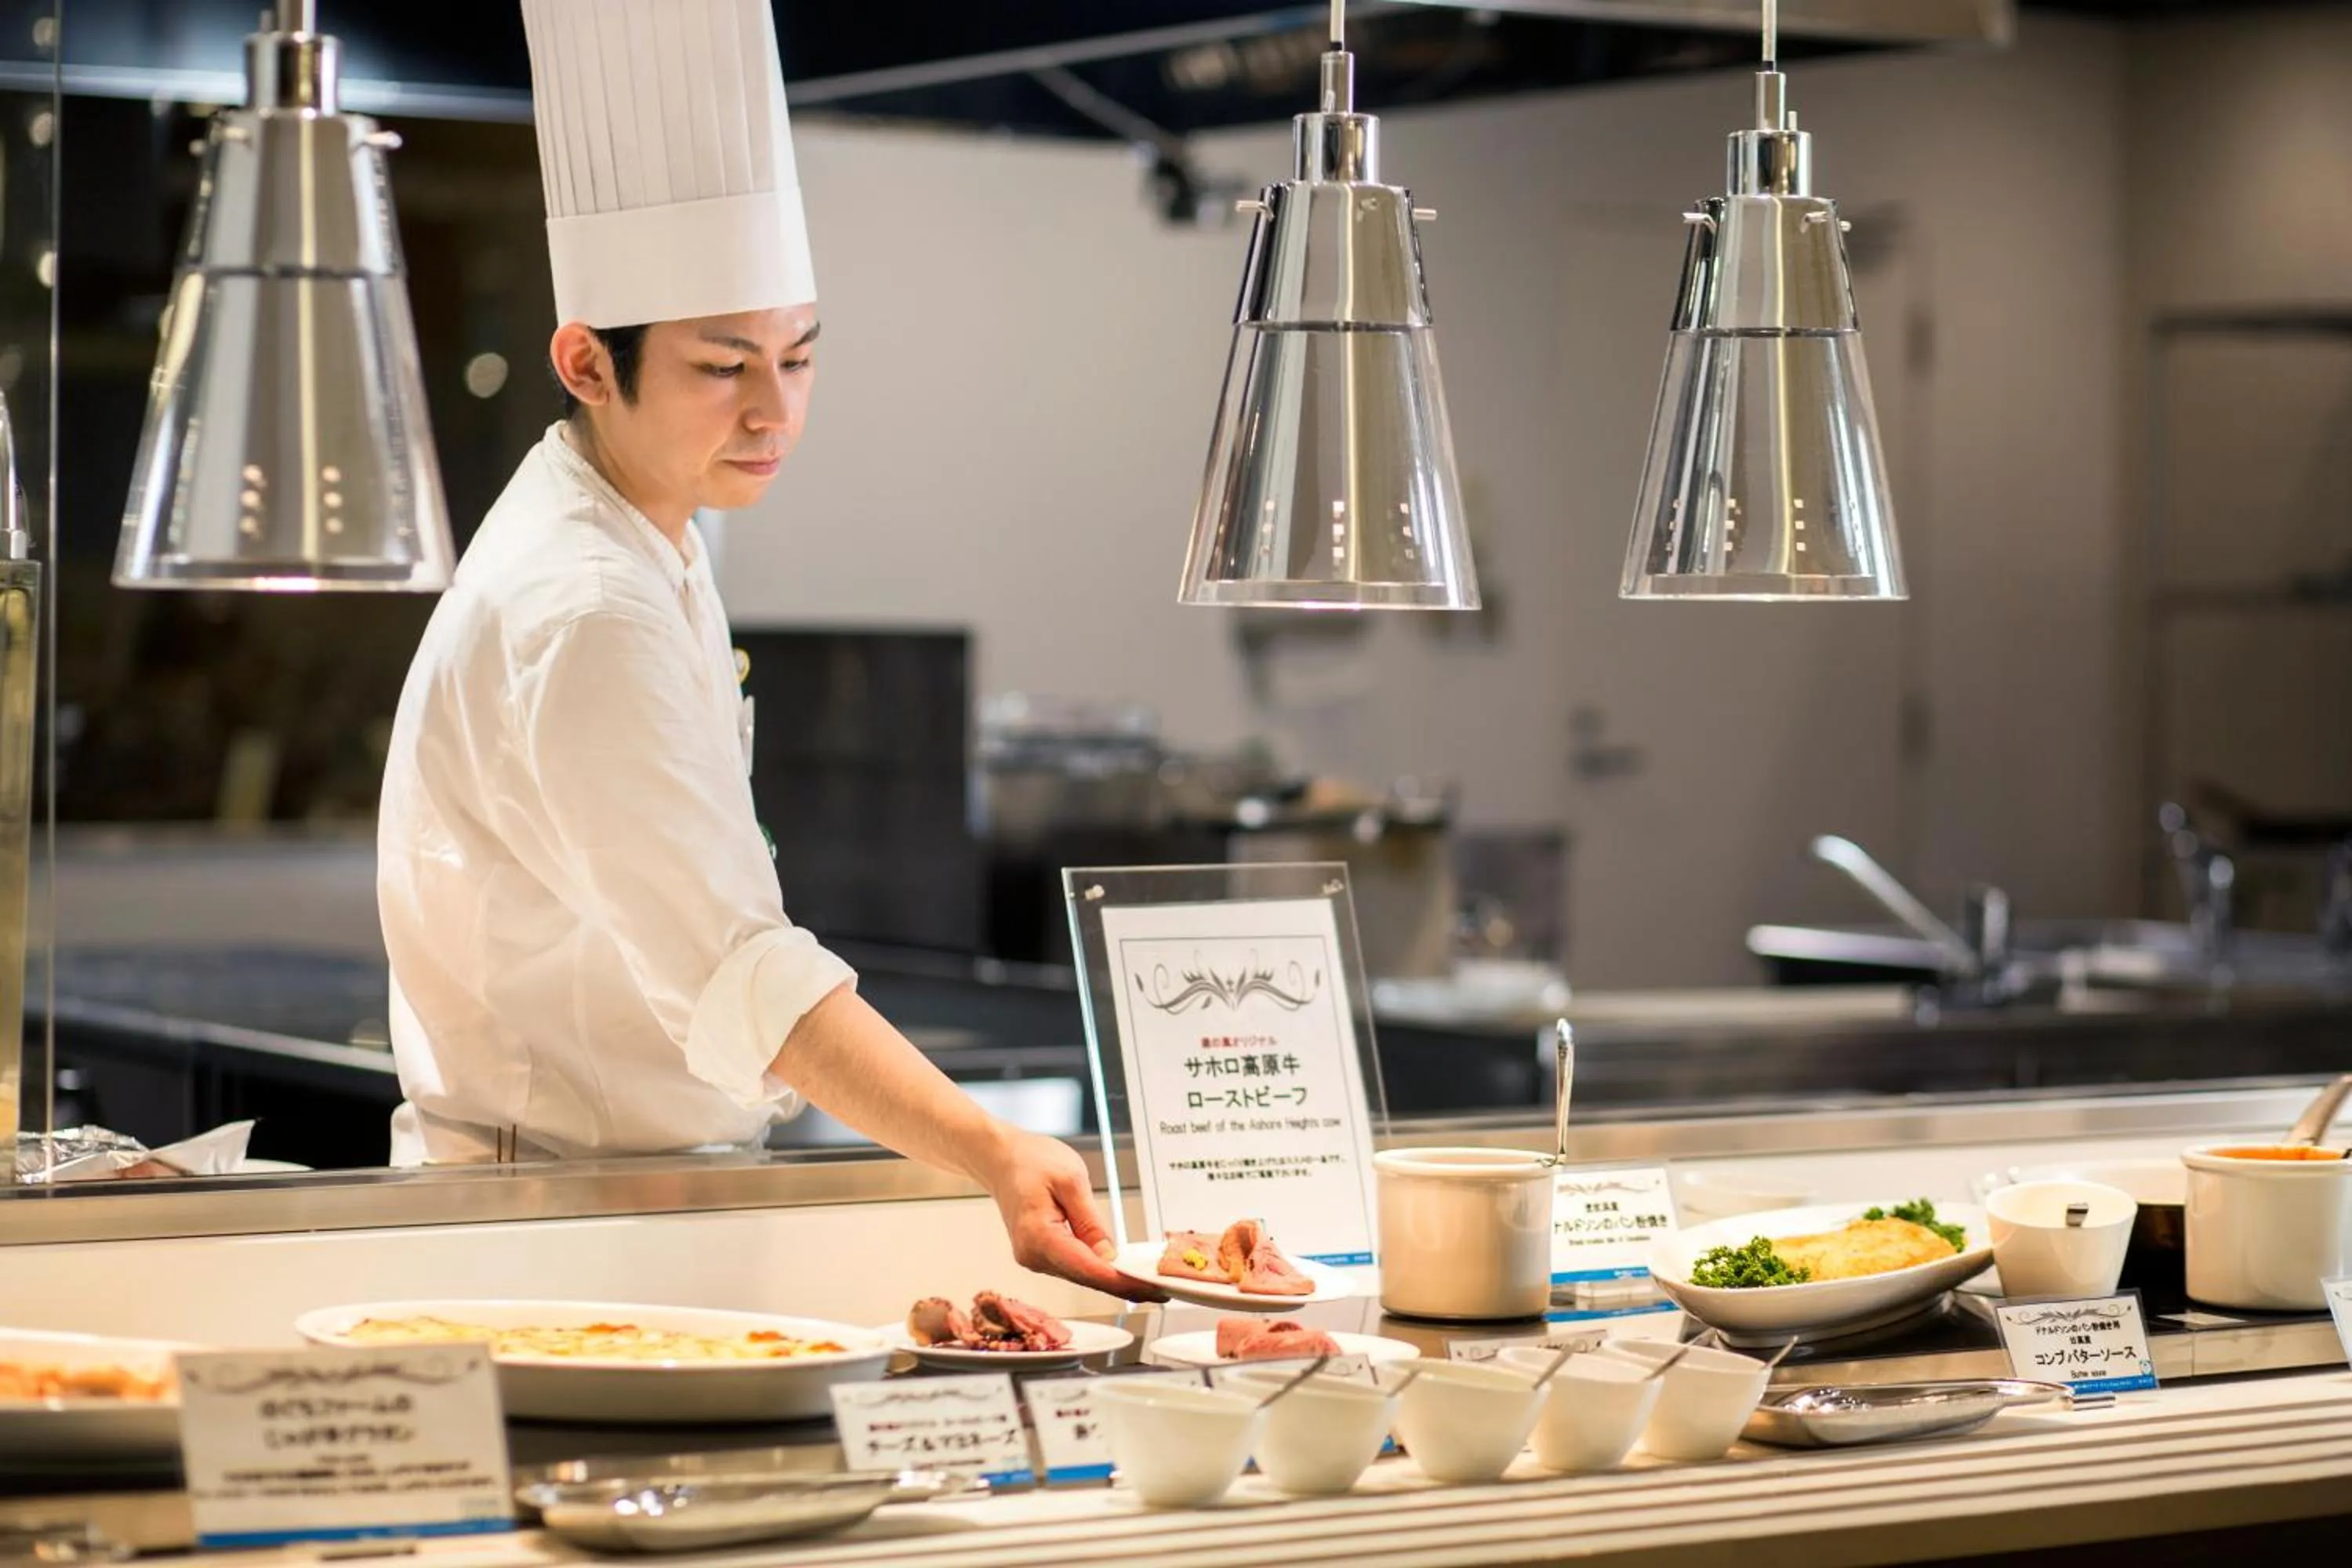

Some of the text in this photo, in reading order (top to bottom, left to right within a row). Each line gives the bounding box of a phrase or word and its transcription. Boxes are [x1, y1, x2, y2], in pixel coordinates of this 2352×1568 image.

[1185, 1053, 1301, 1078] サホロ高原牛
[1187, 1086, 1307, 1108] ローストビーフ
